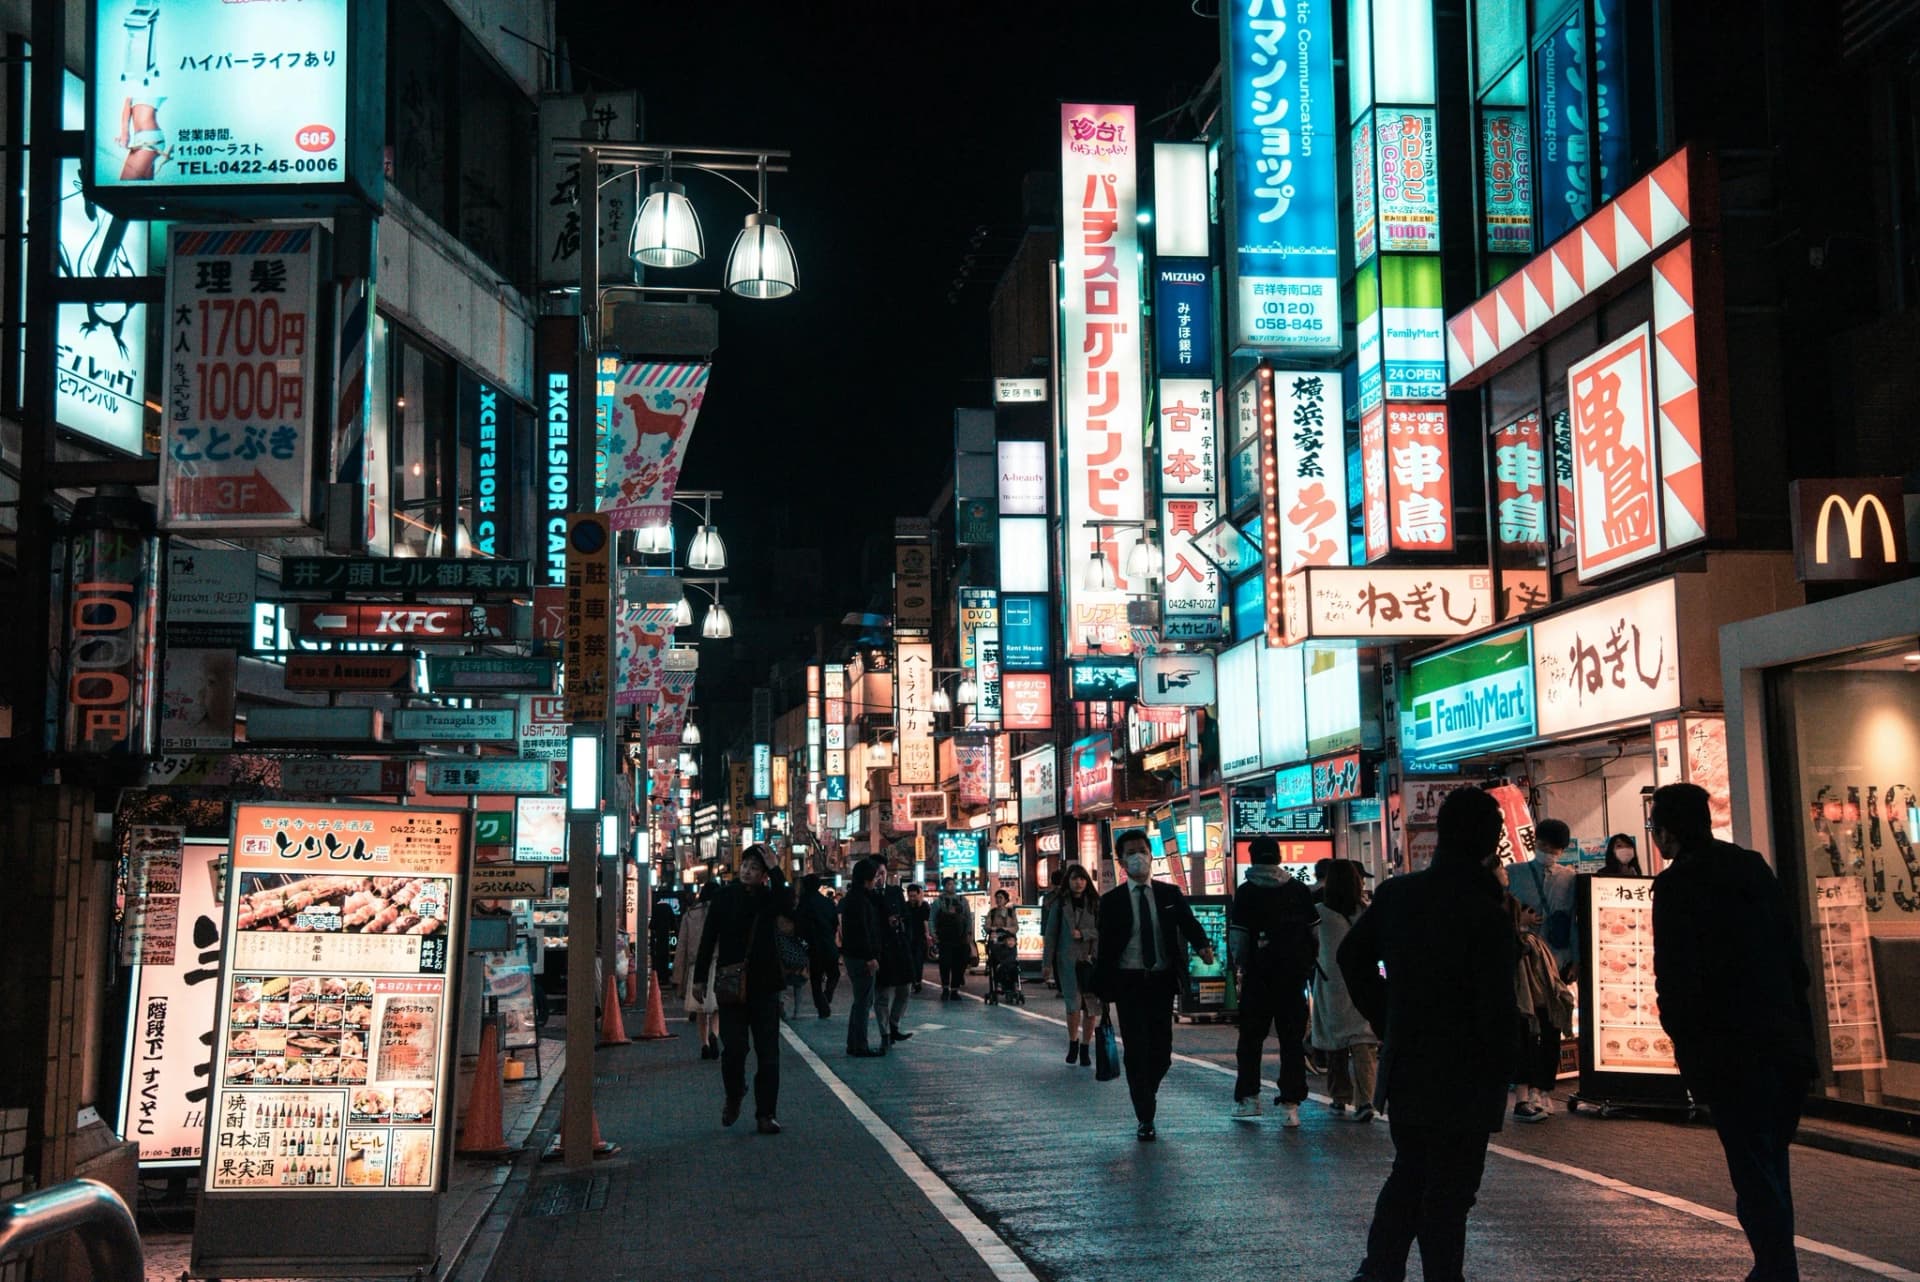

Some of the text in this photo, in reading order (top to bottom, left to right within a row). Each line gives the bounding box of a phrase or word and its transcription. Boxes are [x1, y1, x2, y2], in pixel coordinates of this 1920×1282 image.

[180, 50, 337, 72] ハイパーライフあり
[1298, 28, 1312, 157] Communication
[299, 133, 330, 146] 605
[1070, 117, 1116, 143] 珍台
[178, 157, 338, 175] TEL:0422-45-0006
[196, 259, 287, 293] 理髪
[1161, 271, 1206, 282] MIZUHO
[1252, 283, 1323, 297] 吉祥寺南口店
[1262, 302, 1315, 316] (0120)
[174, 303, 192, 353] 大人
[198, 299, 305, 357] 1700円
[1177, 302, 1193, 365] みずほ銀行
[1255, 318, 1323, 330] 058-845
[1387, 327, 1440, 339] FamilyMart
[196, 361, 304, 420] 1000円
[1389, 384, 1403, 398] 酒
[1290, 375, 1325, 478] 横浜家系
[173, 426, 299, 462] ことぶき
[549, 373, 569, 510] EXCELSIOR
[1162, 400, 1201, 483] 古本
[1577, 370, 1649, 548] 串鳥
[217, 481, 258, 508] 3F
[1392, 440, 1447, 544] 串鳥
[1166, 500, 1205, 583] 買入
[293, 559, 520, 588] 井ノ頭ビル御案内
[967, 610, 991, 620] DVD
[1168, 599, 1216, 609] 0422-47-0727
[1356, 580, 1477, 628] ねぎし
[375, 611, 451, 633] KFC
[1168, 622, 1217, 635] 大竹ビル
[1568, 617, 1664, 709] ねぎし
[478, 715, 497, 725] 358
[1435, 681, 1525, 735] FamilyMart
[443, 769, 481, 784] 理髪
[262, 818, 375, 832] 吉祥寺っ子居酒屋
[390, 826, 459, 835] 0422-46-2417
[275, 831, 373, 861] とりとん
[377, 981, 441, 993] 本日のおすすめ
[226, 1093, 248, 1129] 焼酎
[219, 1130, 271, 1151] 日本酒
[350, 1136, 385, 1150] ビール
[218, 1158, 275, 1179] 果実酒
